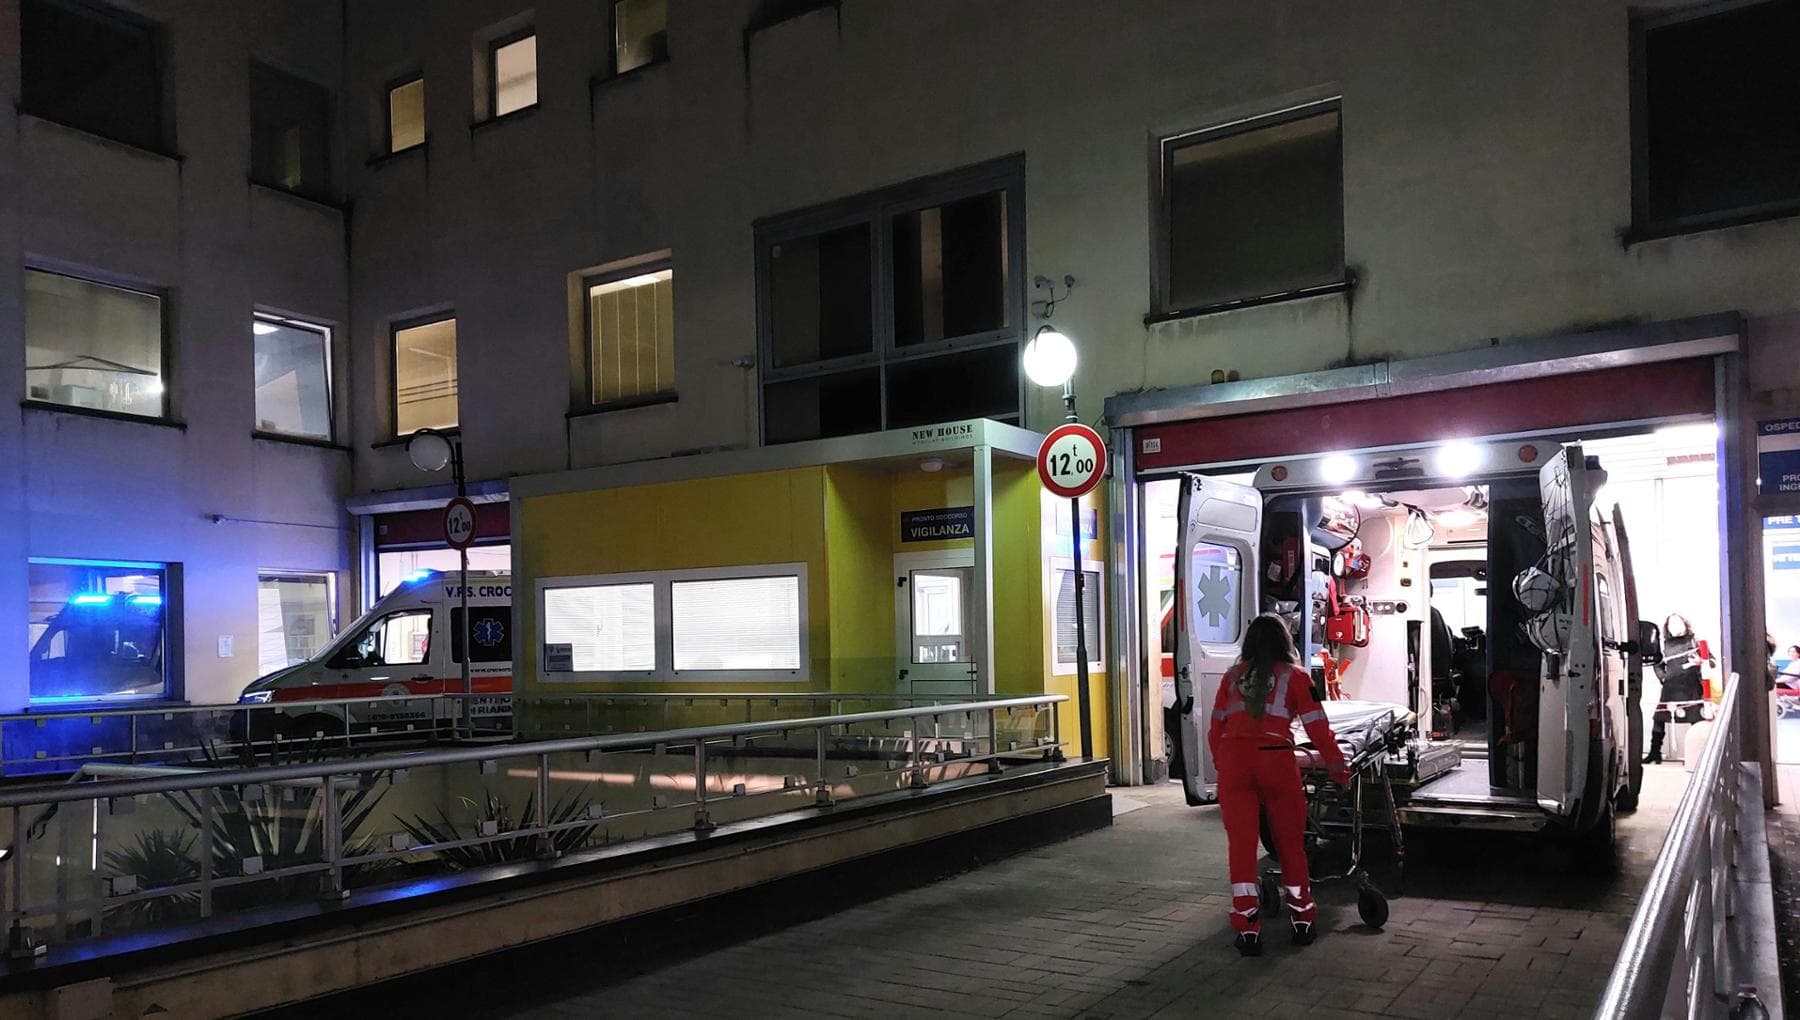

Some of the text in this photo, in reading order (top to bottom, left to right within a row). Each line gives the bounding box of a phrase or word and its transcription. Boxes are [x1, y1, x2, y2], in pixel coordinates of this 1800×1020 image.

[912, 424, 973, 440] NEW HOUSE
[910, 524, 970, 538] VIGILANZA
